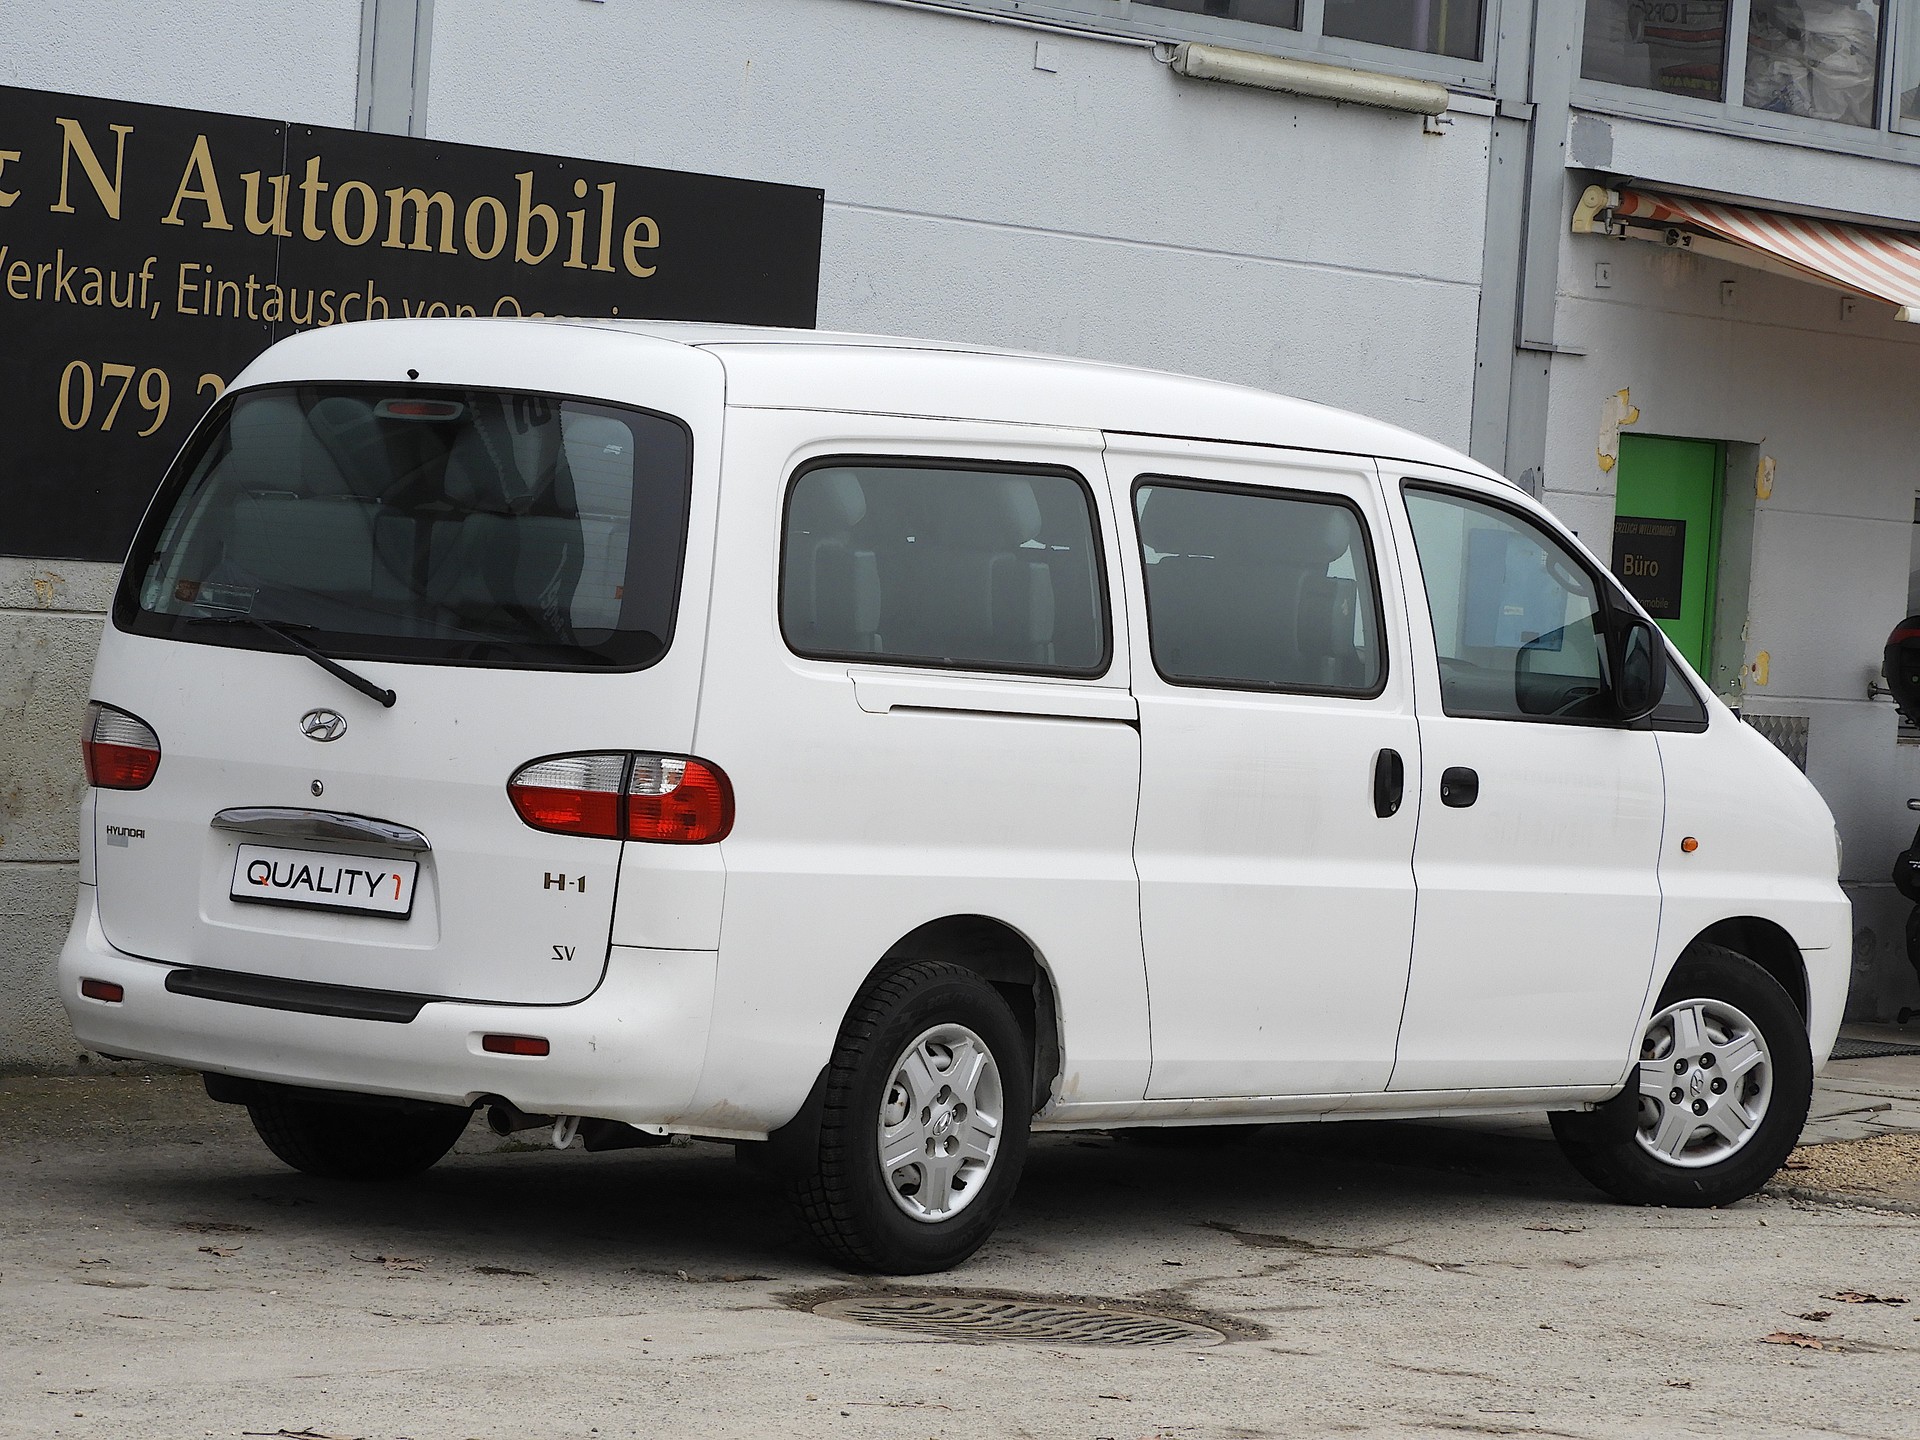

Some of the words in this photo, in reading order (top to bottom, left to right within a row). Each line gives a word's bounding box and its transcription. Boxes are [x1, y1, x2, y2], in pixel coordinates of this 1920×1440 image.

[50, 117, 134, 221] N
[161, 134, 661, 278] Automobile
[177, 263, 389, 326] Eintausch
[58, 360, 171, 437] 079
[1639, 524, 1676, 536] WILLKOMMEN
[1624, 554, 1659, 577] Büro
[1638, 597, 1669, 608] omobile
[106, 825, 146, 839] HYUNDAI
[247, 859, 386, 897] QUALITY
[392, 874, 402, 900] 1
[544, 872, 586, 893] H-1
[551, 945, 576, 961] SV
